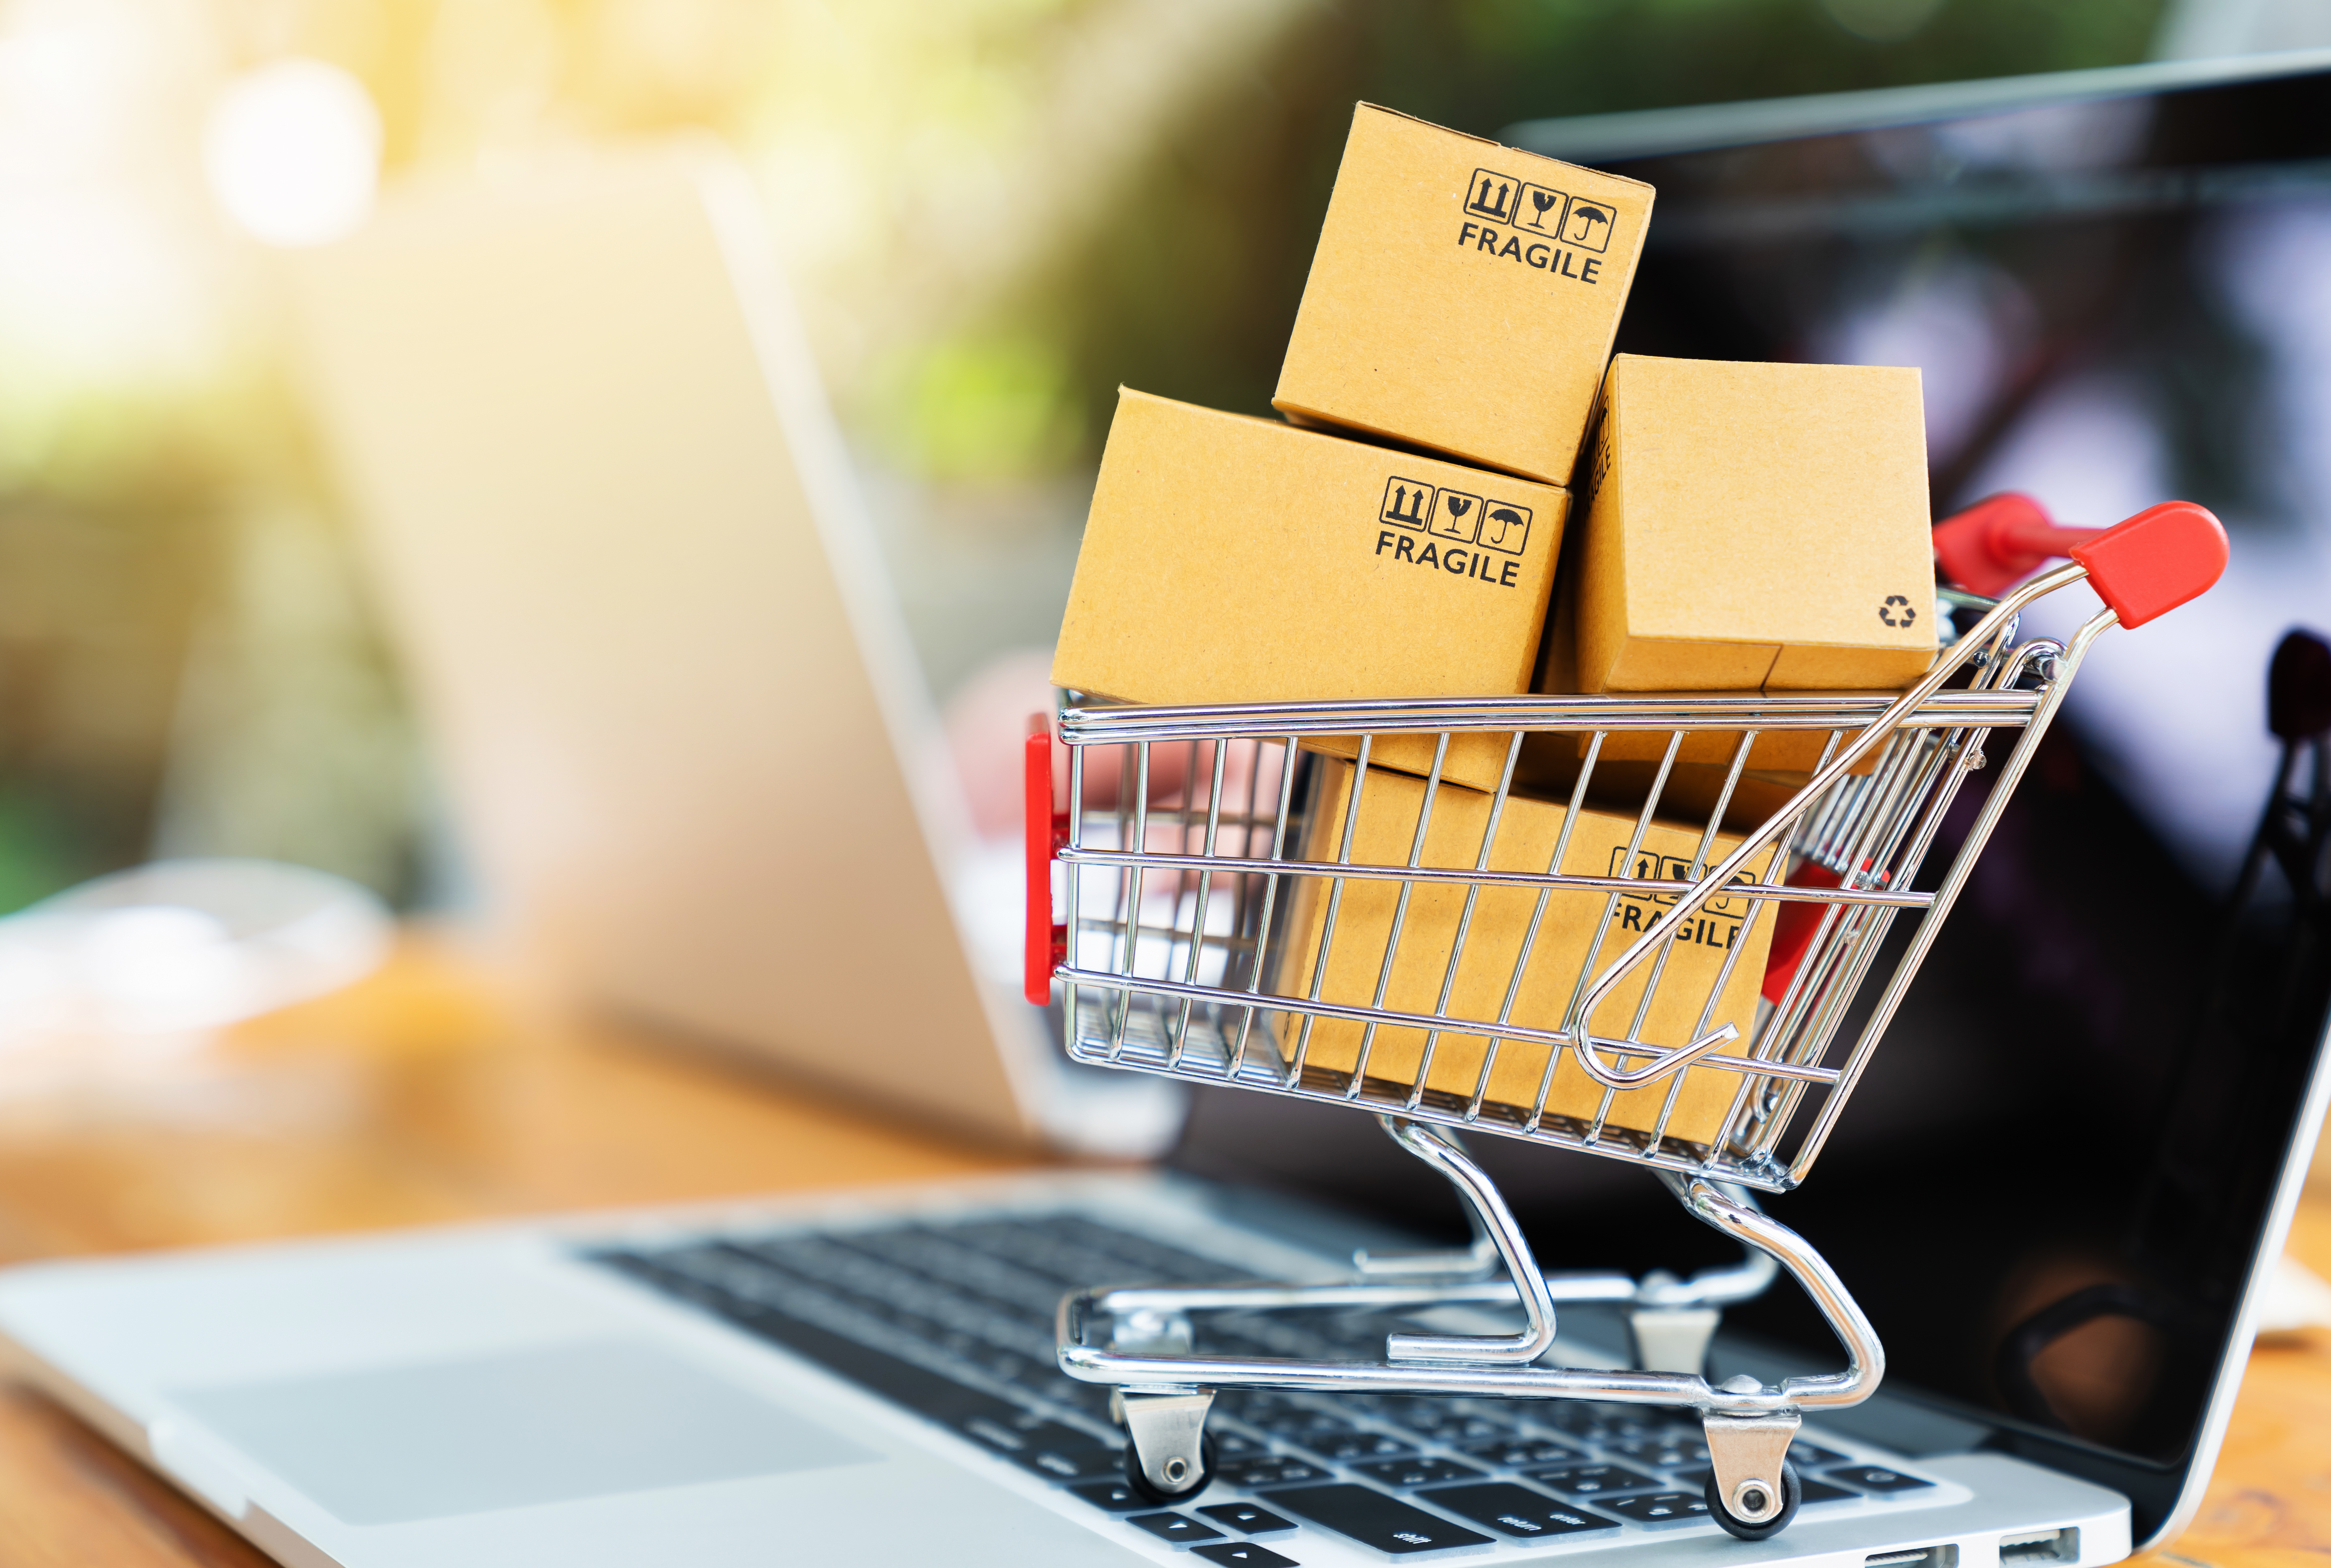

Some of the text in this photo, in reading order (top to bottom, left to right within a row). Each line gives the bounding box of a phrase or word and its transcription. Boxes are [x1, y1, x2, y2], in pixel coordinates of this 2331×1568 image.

[1458, 222, 1602, 284] FRAGILE
[1376, 530, 1520, 587] FRAGILE
[1497, 1517, 1542, 1531] return
[1550, 1514, 1586, 1525] enter
[1393, 1533, 1432, 1544] shift
